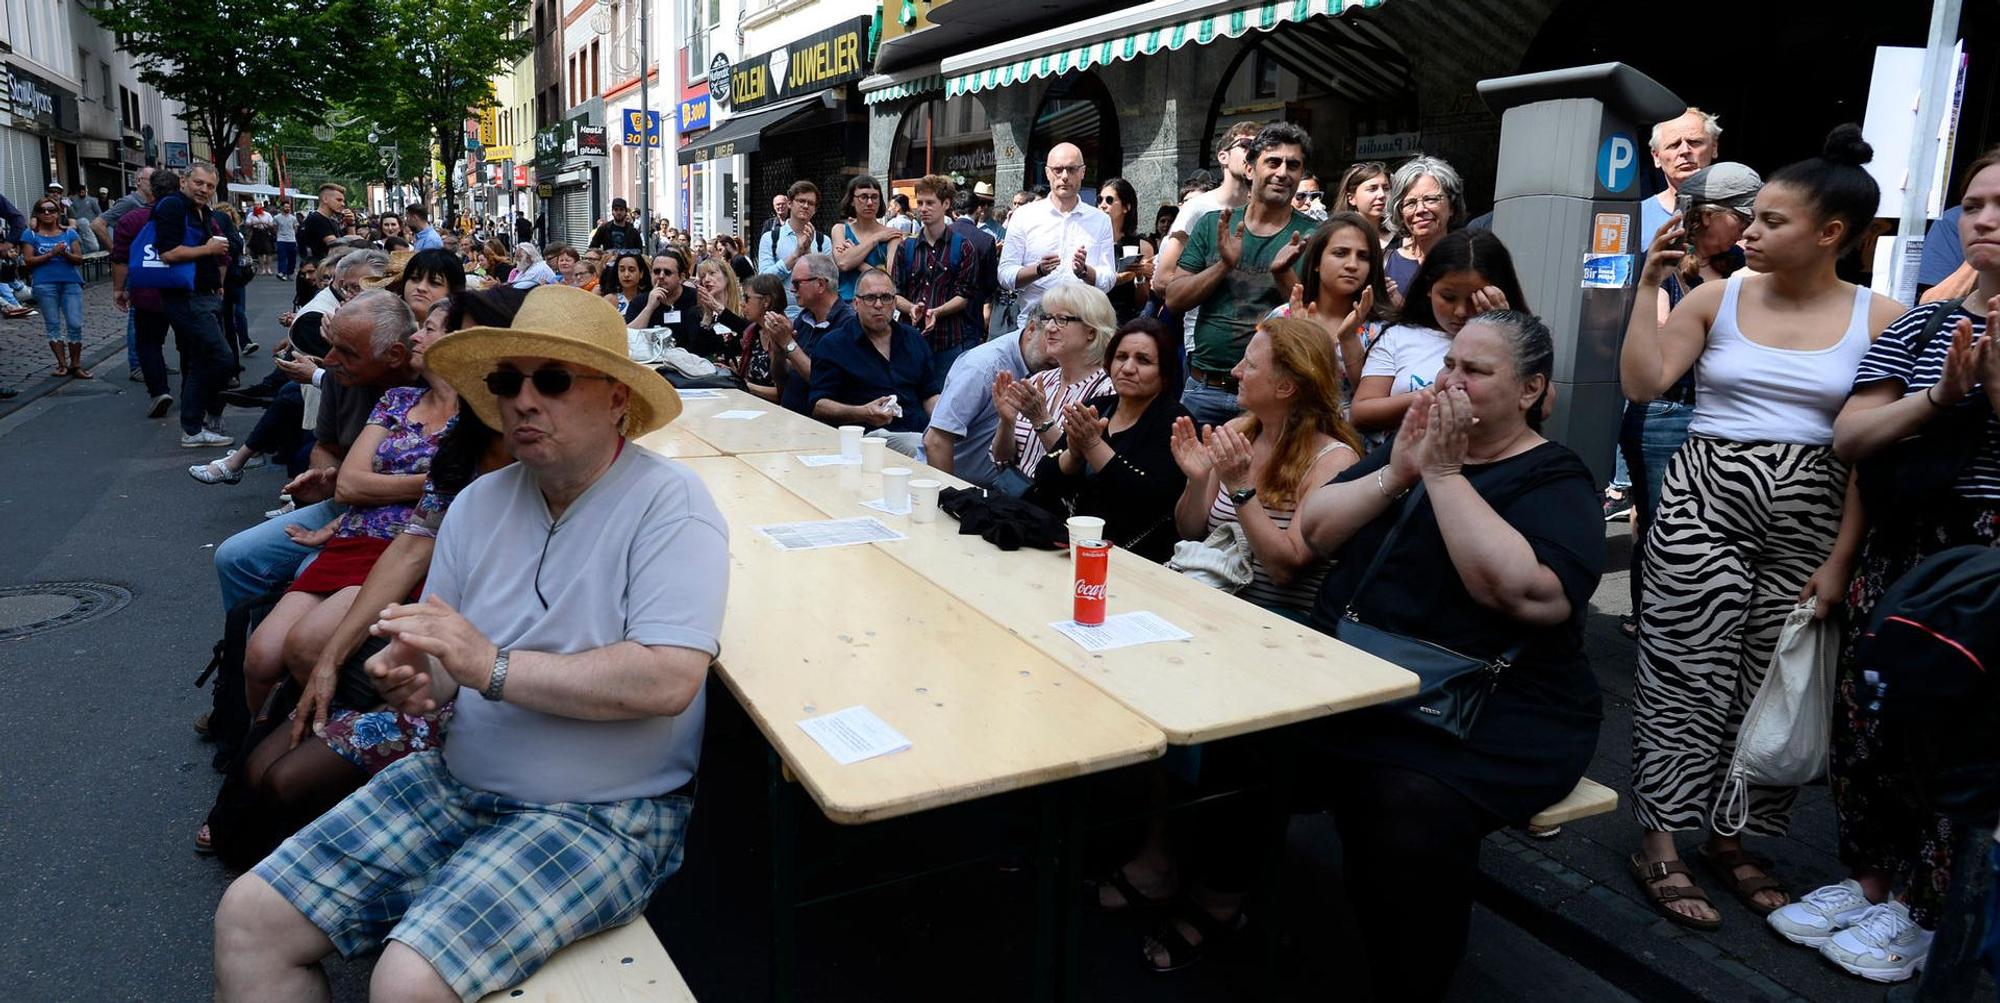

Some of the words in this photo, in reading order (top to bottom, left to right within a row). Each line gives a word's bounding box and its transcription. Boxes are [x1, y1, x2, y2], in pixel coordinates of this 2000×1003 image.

[732, 66, 766, 105] ÖZLEM
[789, 31, 860, 89] JUWELIER
[625, 133, 658, 145] 300
[1608, 136, 1633, 188] P
